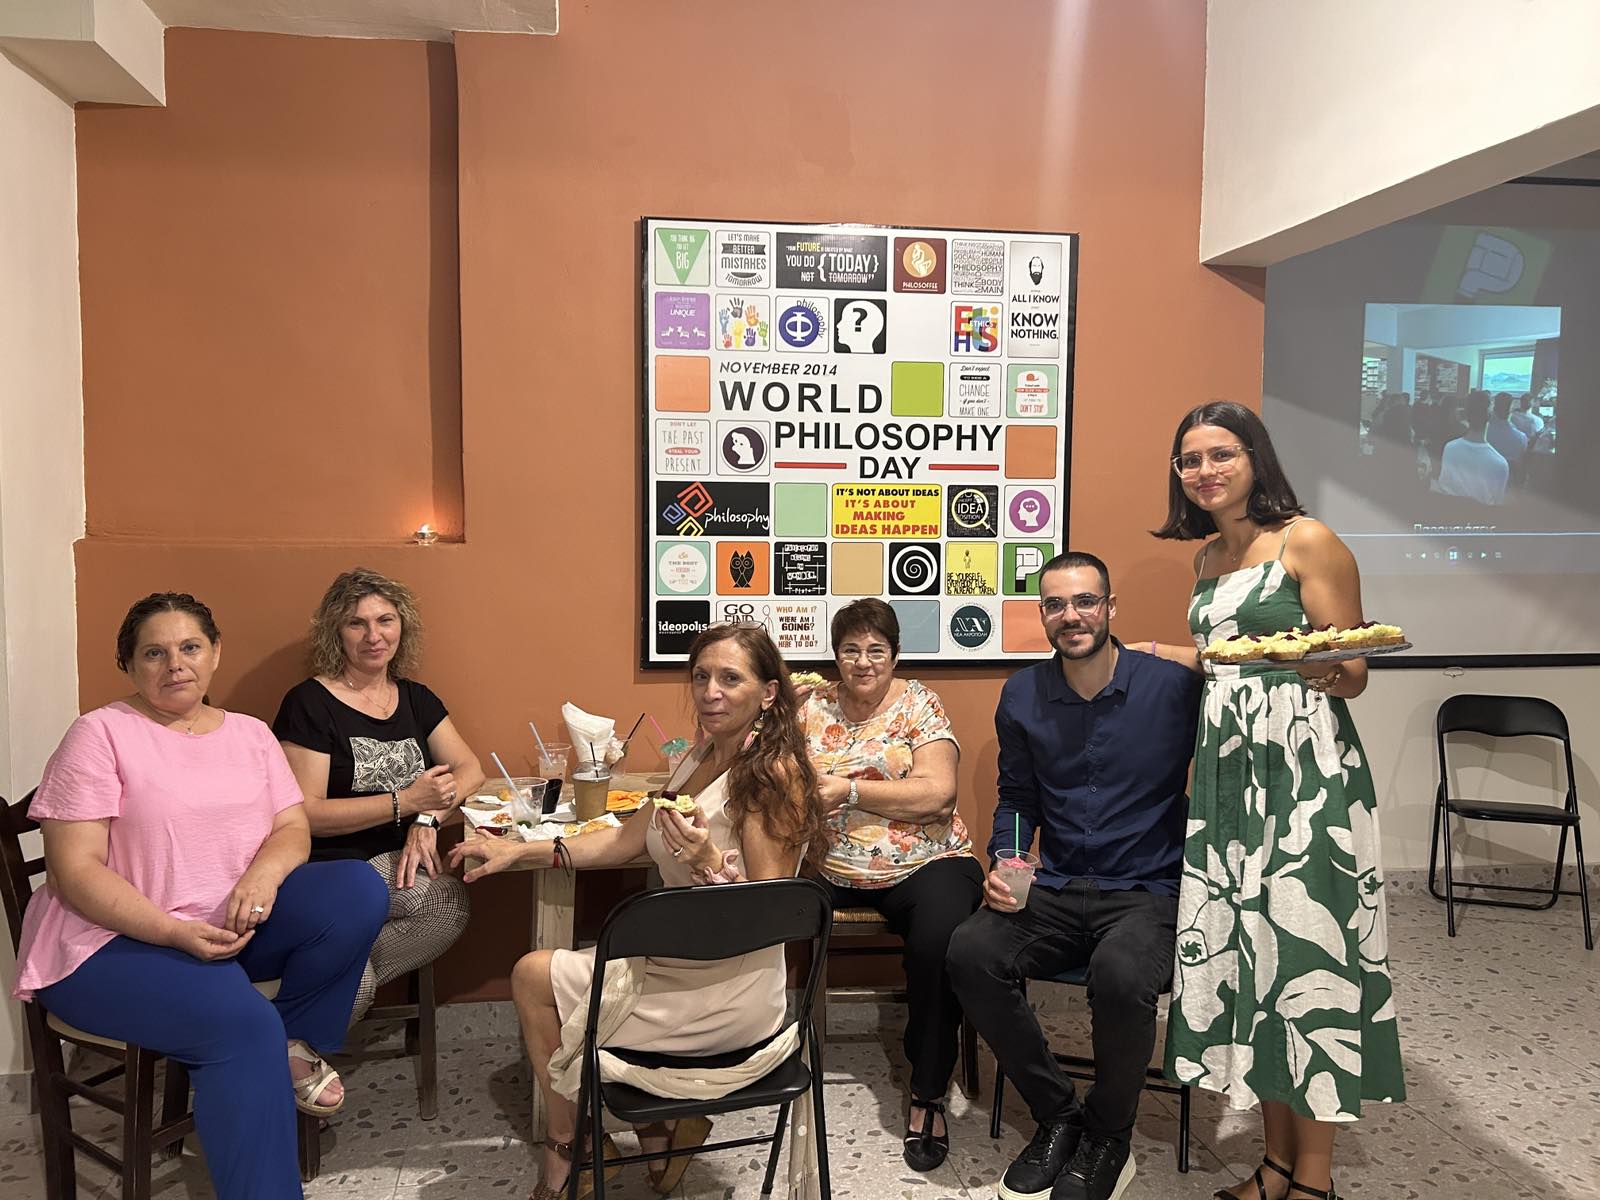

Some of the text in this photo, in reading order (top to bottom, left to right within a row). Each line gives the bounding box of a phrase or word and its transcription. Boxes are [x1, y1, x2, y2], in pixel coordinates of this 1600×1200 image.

[733, 244, 754, 254] BETTER
[797, 242, 820, 252] FUTURE
[676, 251, 689, 269] BIG
[721, 256, 766, 270] MISTAKES
[786, 254, 814, 268] YOU DO
[725, 273, 762, 286] TOMORROW
[800, 272, 814, 282] NOT
[1012, 294, 1060, 304] ALL I KNOW
[670, 310, 696, 318] UNIQUE
[1011, 312, 1058, 327] KNOW
[1011, 329, 1058, 340] NOTHING.
[720, 362, 838, 376] NOVEMBER 2014
[960, 384, 990, 396] CHANGE
[719, 380, 882, 414] WORLD
[960, 406, 990, 416] MAKE ONE
[662, 430, 704, 444] THE PAST
[774, 421, 1002, 450] PHILOSOPHY
[666, 458, 700, 472] PRESENT
[859, 456, 921, 479] DAY
[845, 500, 916, 508] IT'S ABOUT
[957, 503, 984, 514] IDEA
[705, 508, 770, 530] philosophy
[853, 511, 906, 520] MAKING
[836, 524, 938, 535] IDEAS HAPPEN
[724, 604, 754, 614] GO
[658, 620, 708, 634] ideopolis
[782, 622, 815, 631] GOING?
